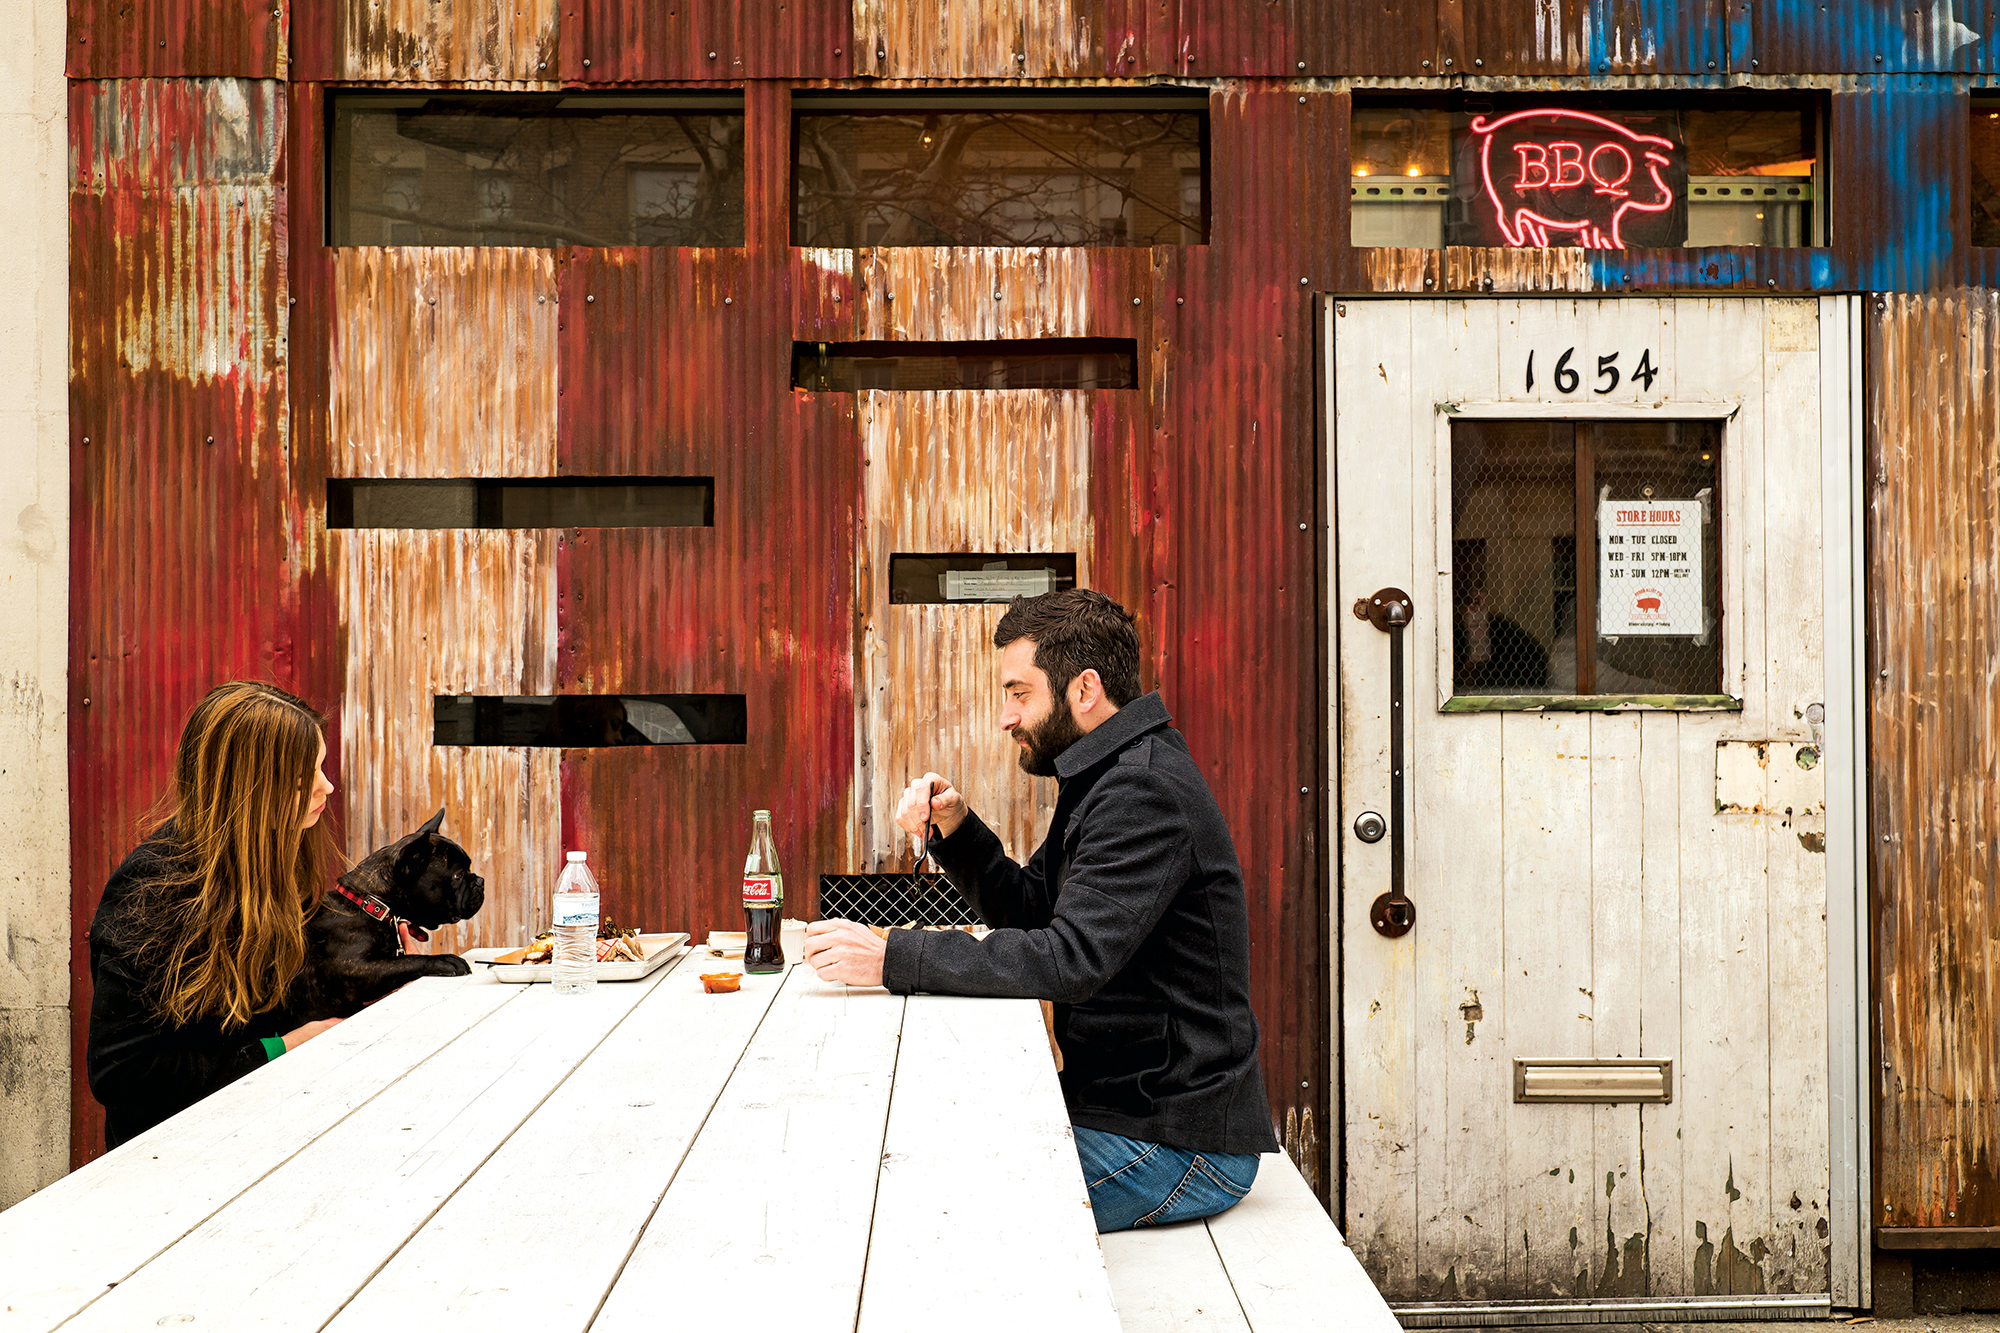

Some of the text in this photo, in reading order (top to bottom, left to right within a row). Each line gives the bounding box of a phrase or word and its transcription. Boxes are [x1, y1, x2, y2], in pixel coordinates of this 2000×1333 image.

[1513, 141, 1632, 197] BBQ
[1526, 346, 1659, 394] 1654
[1616, 510, 1681, 522] STORE HOURS
[1609, 535, 1624, 545] MON
[1631, 535, 1646, 545] TUE
[1651, 535, 1678, 545] CLOSED
[1608, 552, 1624, 561] WED
[1631, 552, 1645, 561] FRI
[1609, 569, 1624, 578] SAT
[1631, 569, 1646, 578] SUN
